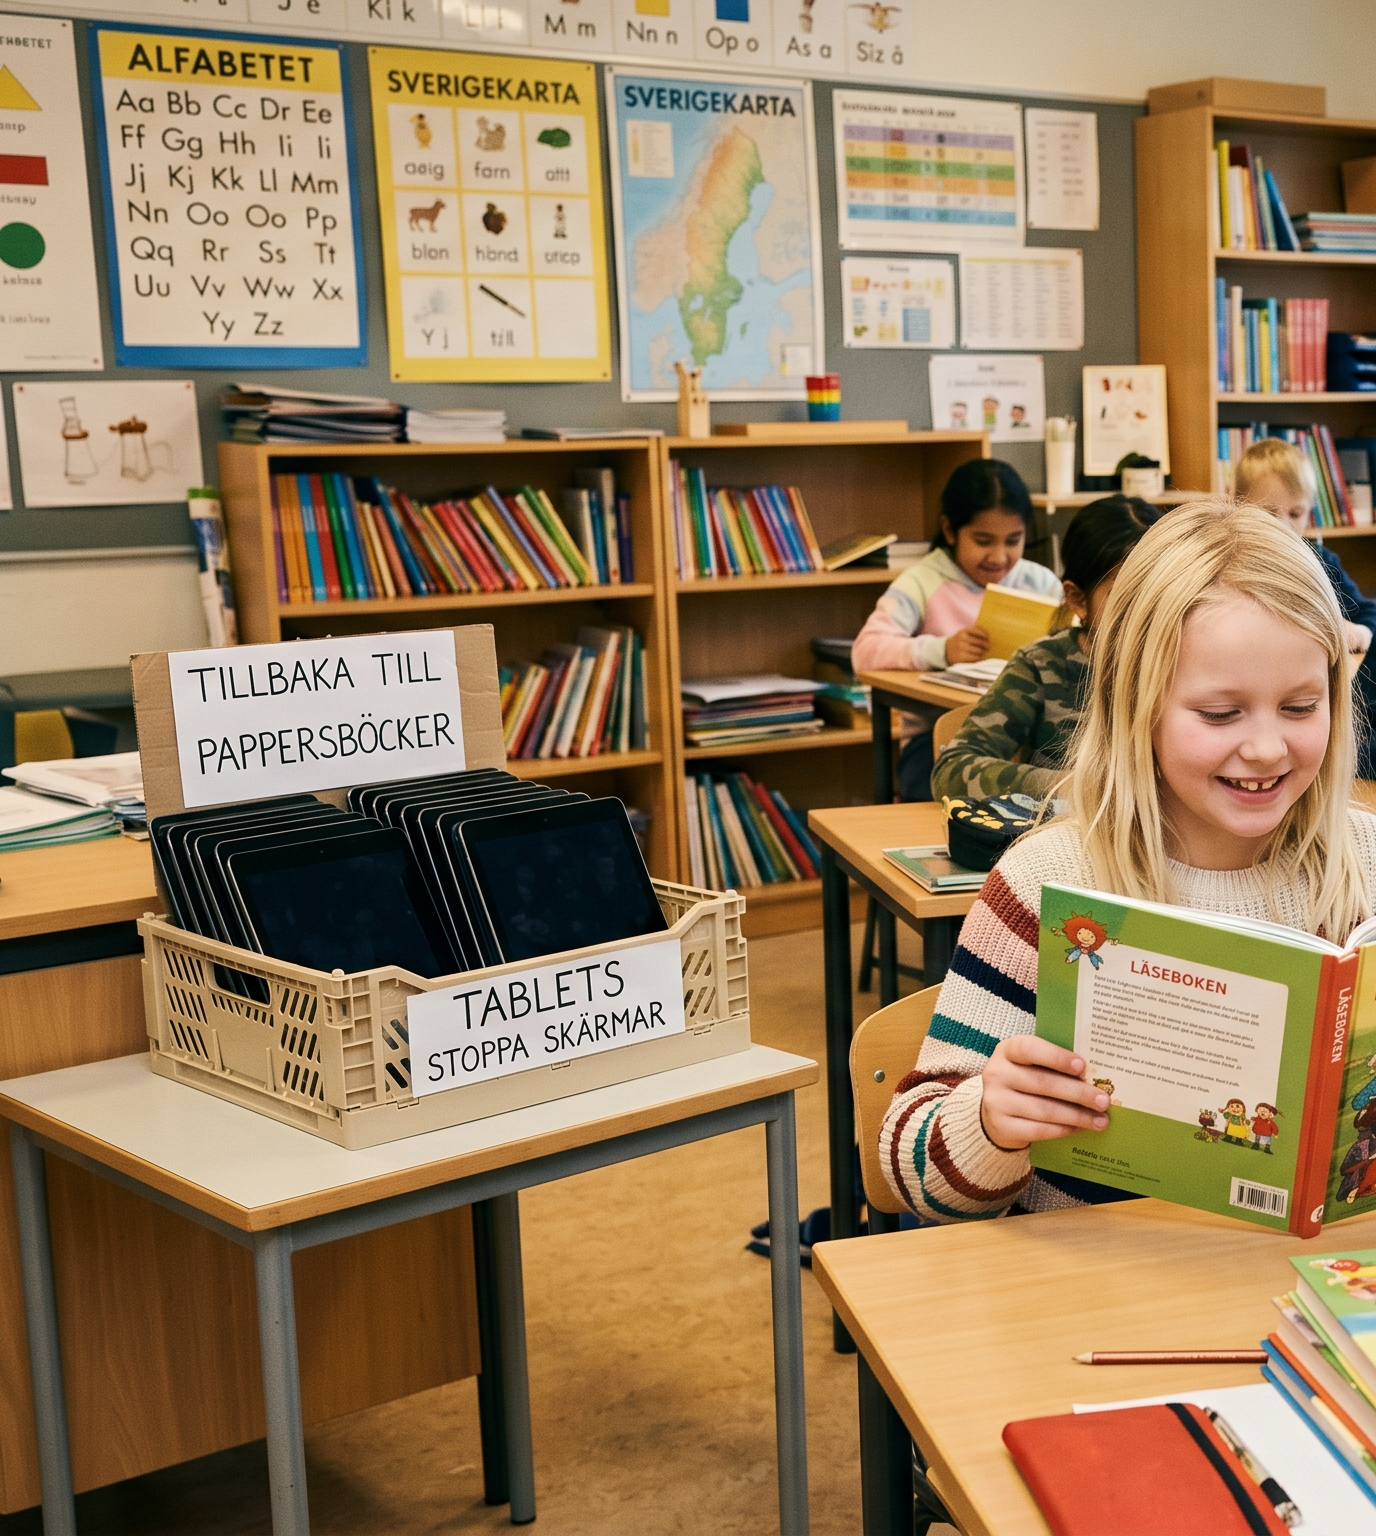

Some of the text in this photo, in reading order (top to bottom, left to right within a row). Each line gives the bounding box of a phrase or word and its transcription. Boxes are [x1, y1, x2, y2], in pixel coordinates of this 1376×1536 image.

[545, 15, 596, 38] M m
[627, 20, 678, 45] Nn n
[706, 27, 738, 56] Op
[128, 43, 313, 83] ALFABETET
[786, 37, 832, 59] As a
[387, 70, 581, 105] SVERIGEKARTA
[624, 86, 796, 117] SVERIGEKARTA
[116, 89, 332, 124] Aa Bb Cc Dr Ee
[121, 124, 146, 149] Ff
[161, 127, 203, 160] Gg
[219, 131, 255, 155] Hh
[125, 163, 339, 195] Jj Kj Kk Ll Mm
[128, 200, 337, 236] Nn Oo Oo Pp
[130, 236, 336, 267] Qq Rr Ss Tt
[134, 274, 343, 301] Uu Vv Ww Xx
[203, 311, 284, 341] Yy Zz
[188, 651, 442, 703] TILLBAKA TILL
[197, 712, 455, 775] PAPPERSBÖCKER
[1130, 959, 1227, 995] LÄSEBOKEN
[453, 960, 625, 1030] TABLETS
[428, 1001, 666, 1082] STOPPA SKÄRMAR
